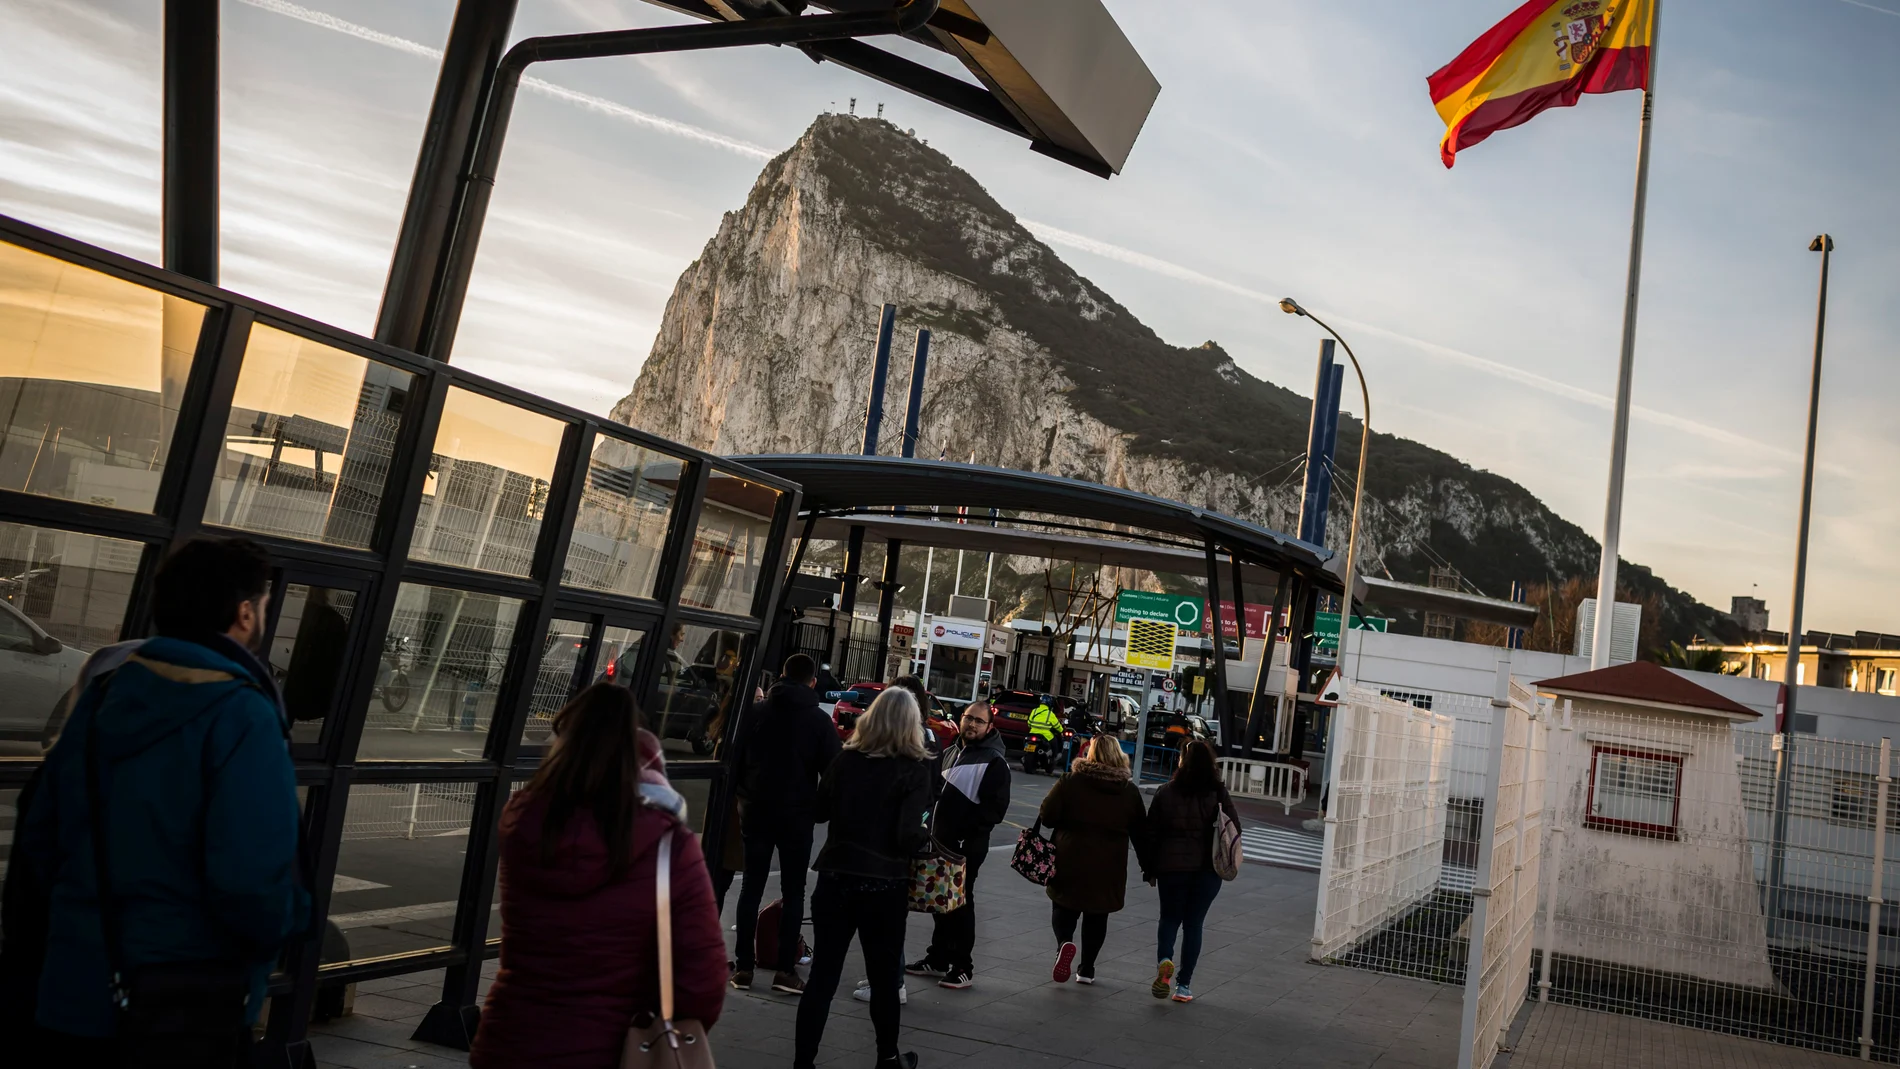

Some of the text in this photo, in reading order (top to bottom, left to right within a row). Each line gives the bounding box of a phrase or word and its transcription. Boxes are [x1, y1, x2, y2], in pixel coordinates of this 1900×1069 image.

[1120, 607, 1142, 616] Nothing
[895, 626, 913, 635] STOP
[1118, 671, 1143, 679] CHECK-IN
